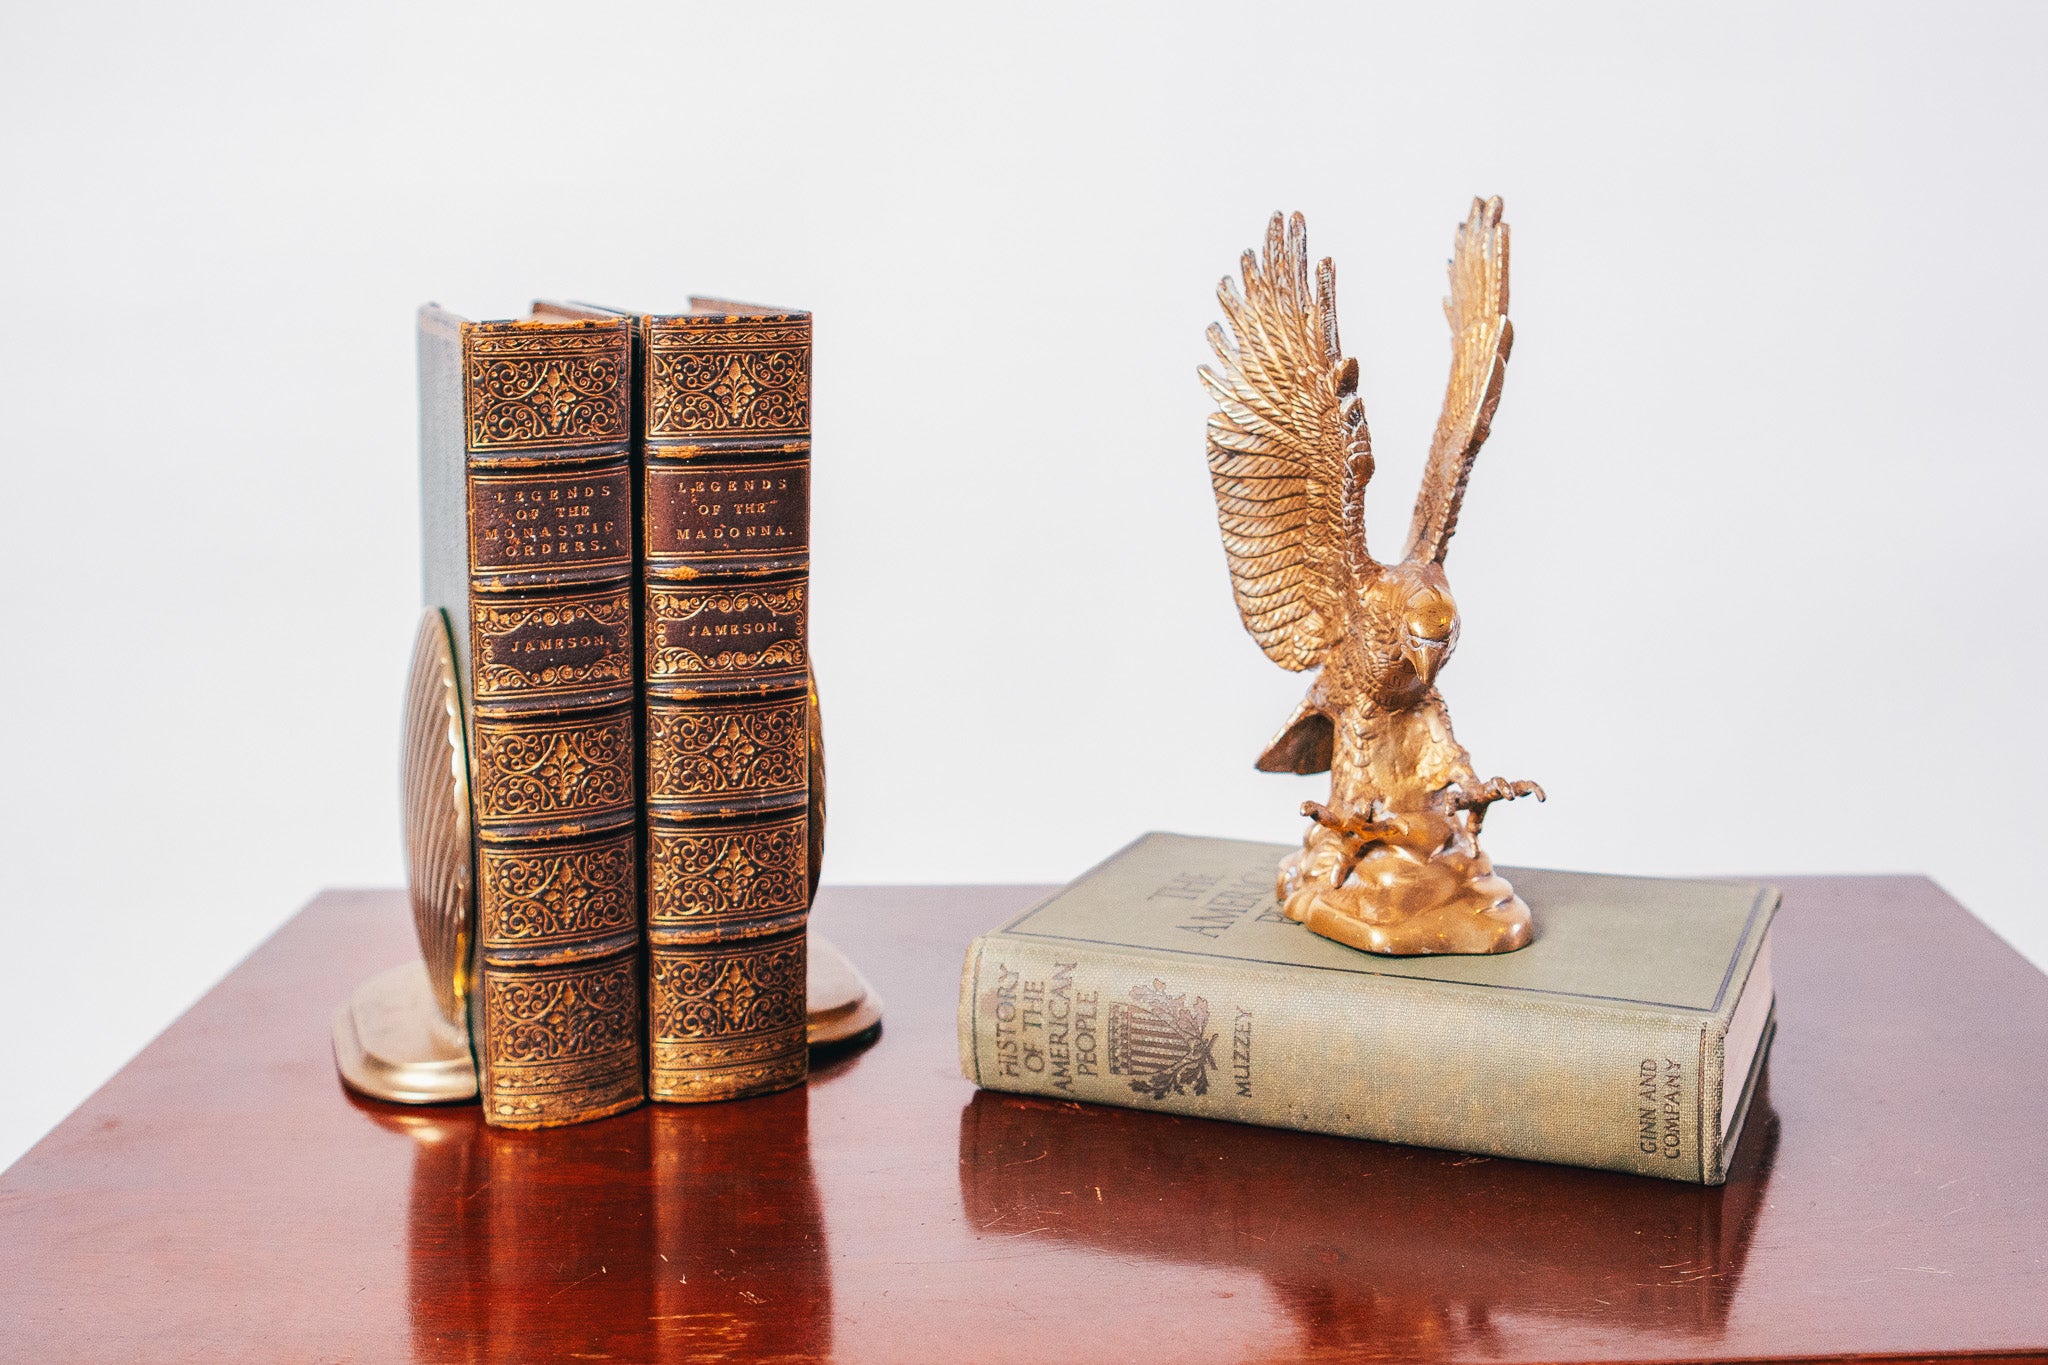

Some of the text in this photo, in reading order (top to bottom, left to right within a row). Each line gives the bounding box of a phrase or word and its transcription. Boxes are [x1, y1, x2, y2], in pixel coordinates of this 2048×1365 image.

[496, 485, 611, 503] LEGENDS
[678, 479, 787, 493] LEGENDS
[515, 505, 590, 520] OF THE
[698, 502, 766, 515] OF THE
[485, 521, 614, 540] MONASTIC
[676, 525, 793, 540] MADONNA.
[505, 539, 607, 557] ORDERS.
[687, 620, 785, 637] JAMESON.
[995, 963, 1019, 1078] HISTORY
[1022, 980, 1045, 1073] OF THE
[1048, 960, 1078, 1094] AMERICAN
[1074, 990, 1098, 1077] PEOPLE
[1232, 1005, 1252, 1098] MUZZEY
[1639, 1059, 1657, 1154] GINN AND
[1663, 1058, 1681, 1160] COMPANY
